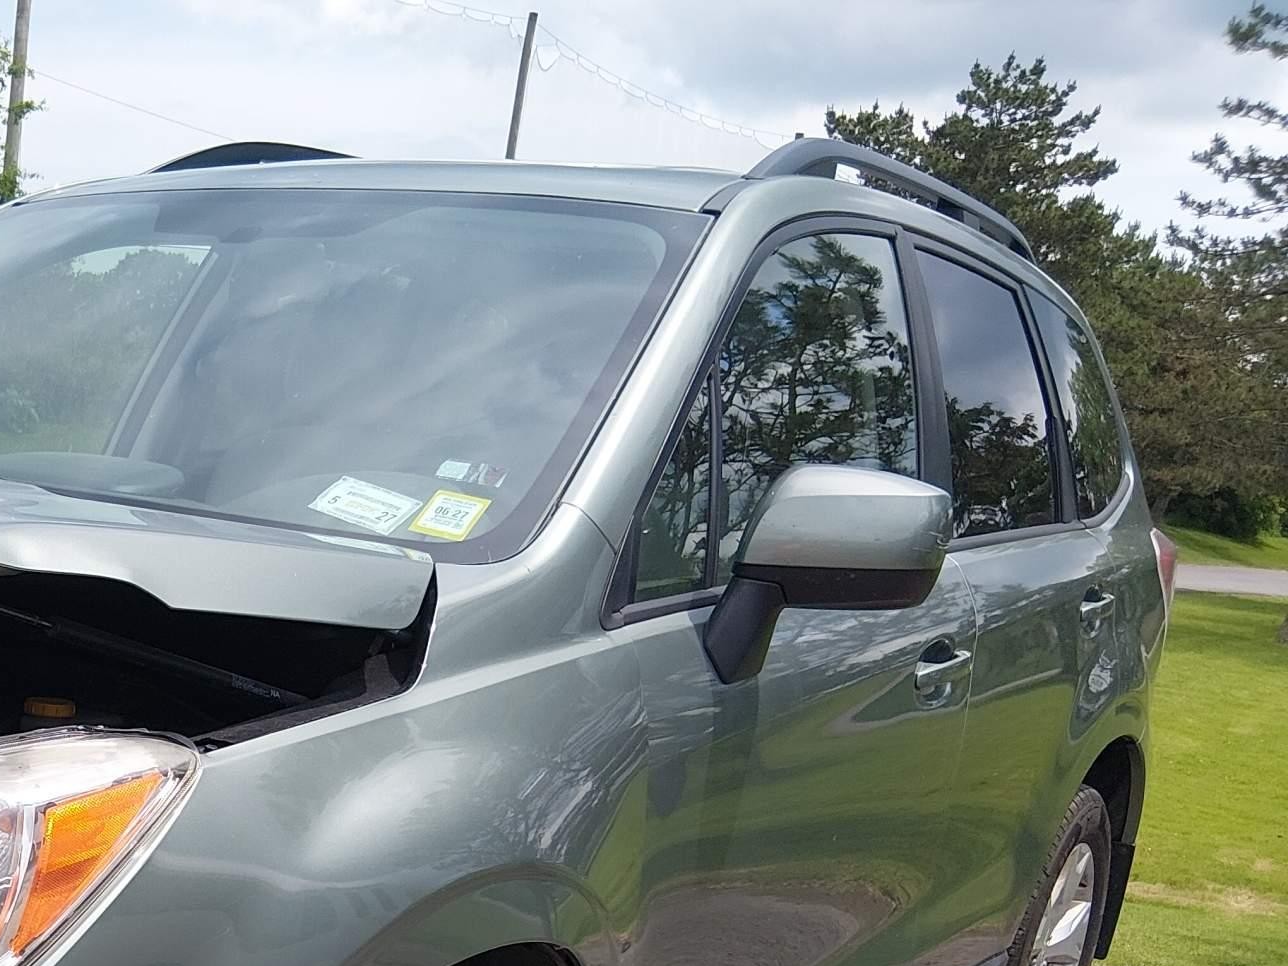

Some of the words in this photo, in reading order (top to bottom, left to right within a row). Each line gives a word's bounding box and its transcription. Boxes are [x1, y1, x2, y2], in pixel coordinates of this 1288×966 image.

[326, 495, 342, 506] 5
[375, 510, 398, 523] 27
[434, 505, 451, 516] 06
[452, 509, 470, 520] 27
